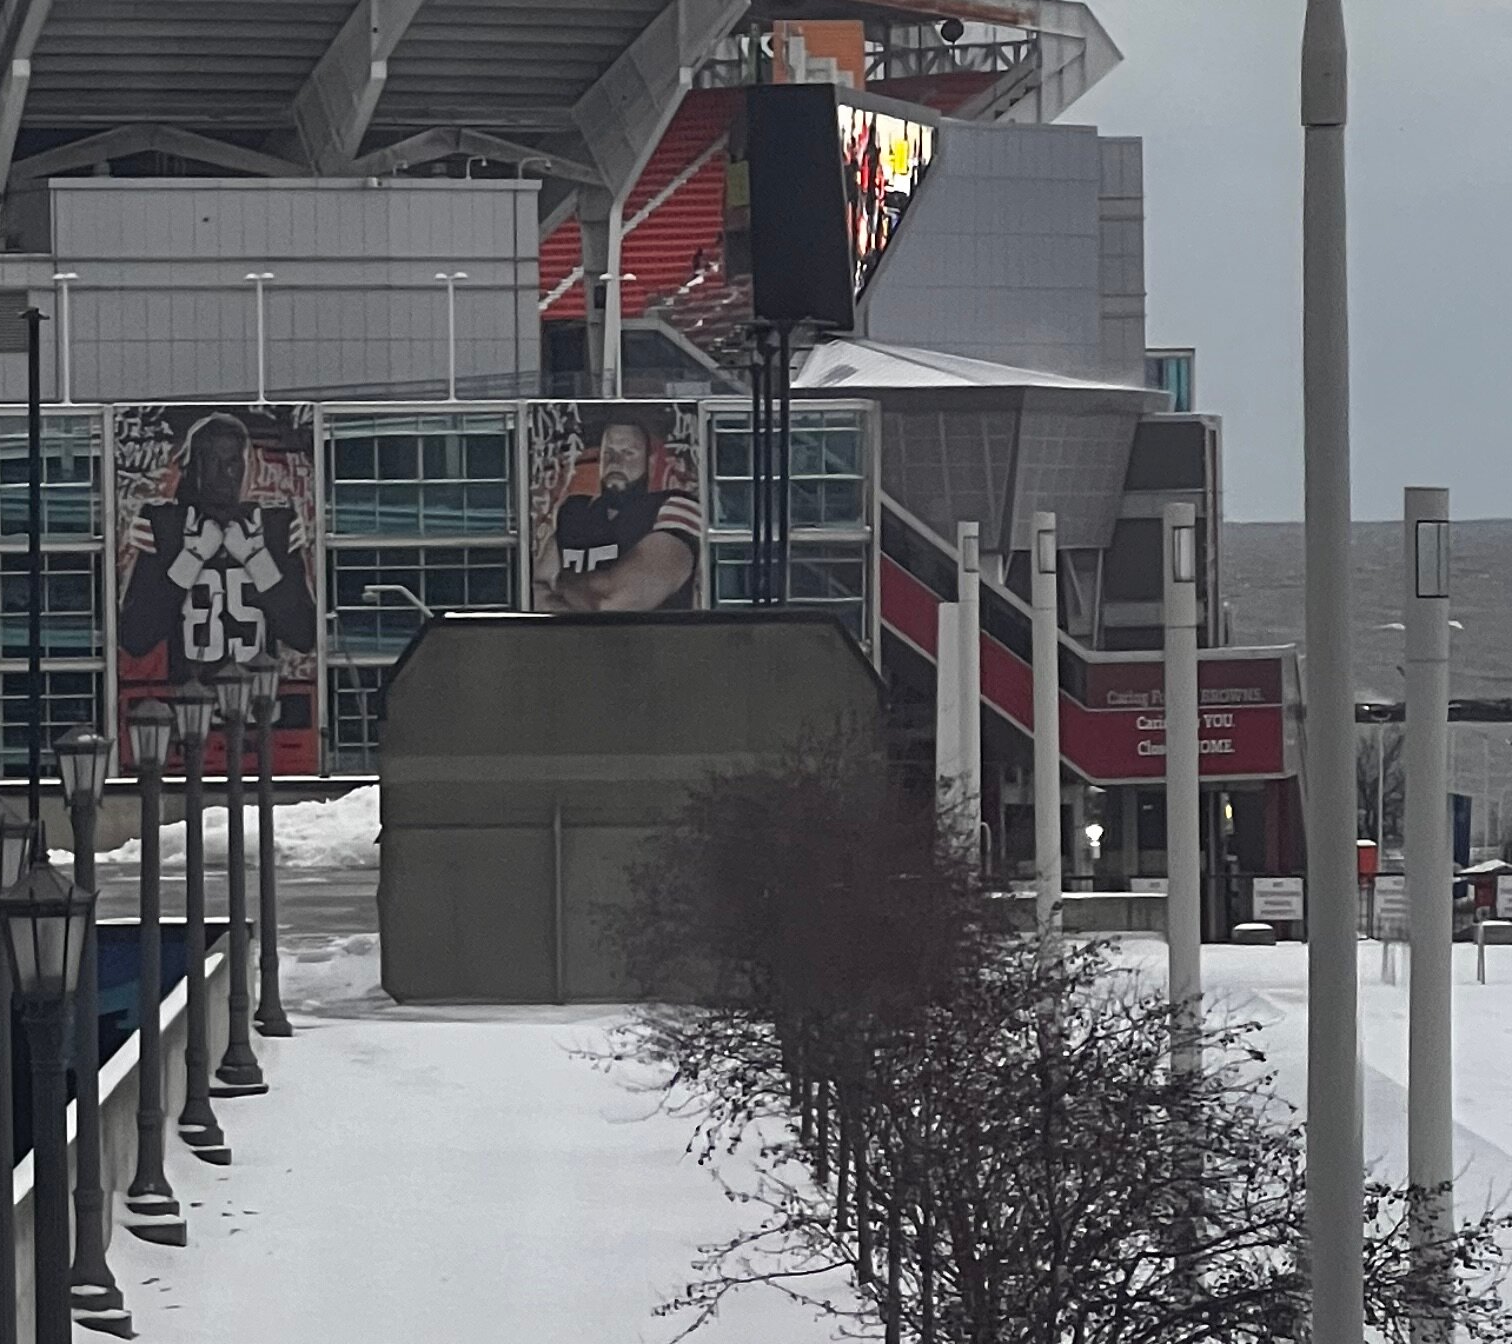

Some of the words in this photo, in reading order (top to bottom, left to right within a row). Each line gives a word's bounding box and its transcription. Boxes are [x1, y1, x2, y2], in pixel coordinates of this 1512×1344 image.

[182, 567, 266, 662] 85
[1136, 715, 1166, 730] Cari
[1199, 738, 1235, 754] OME.
